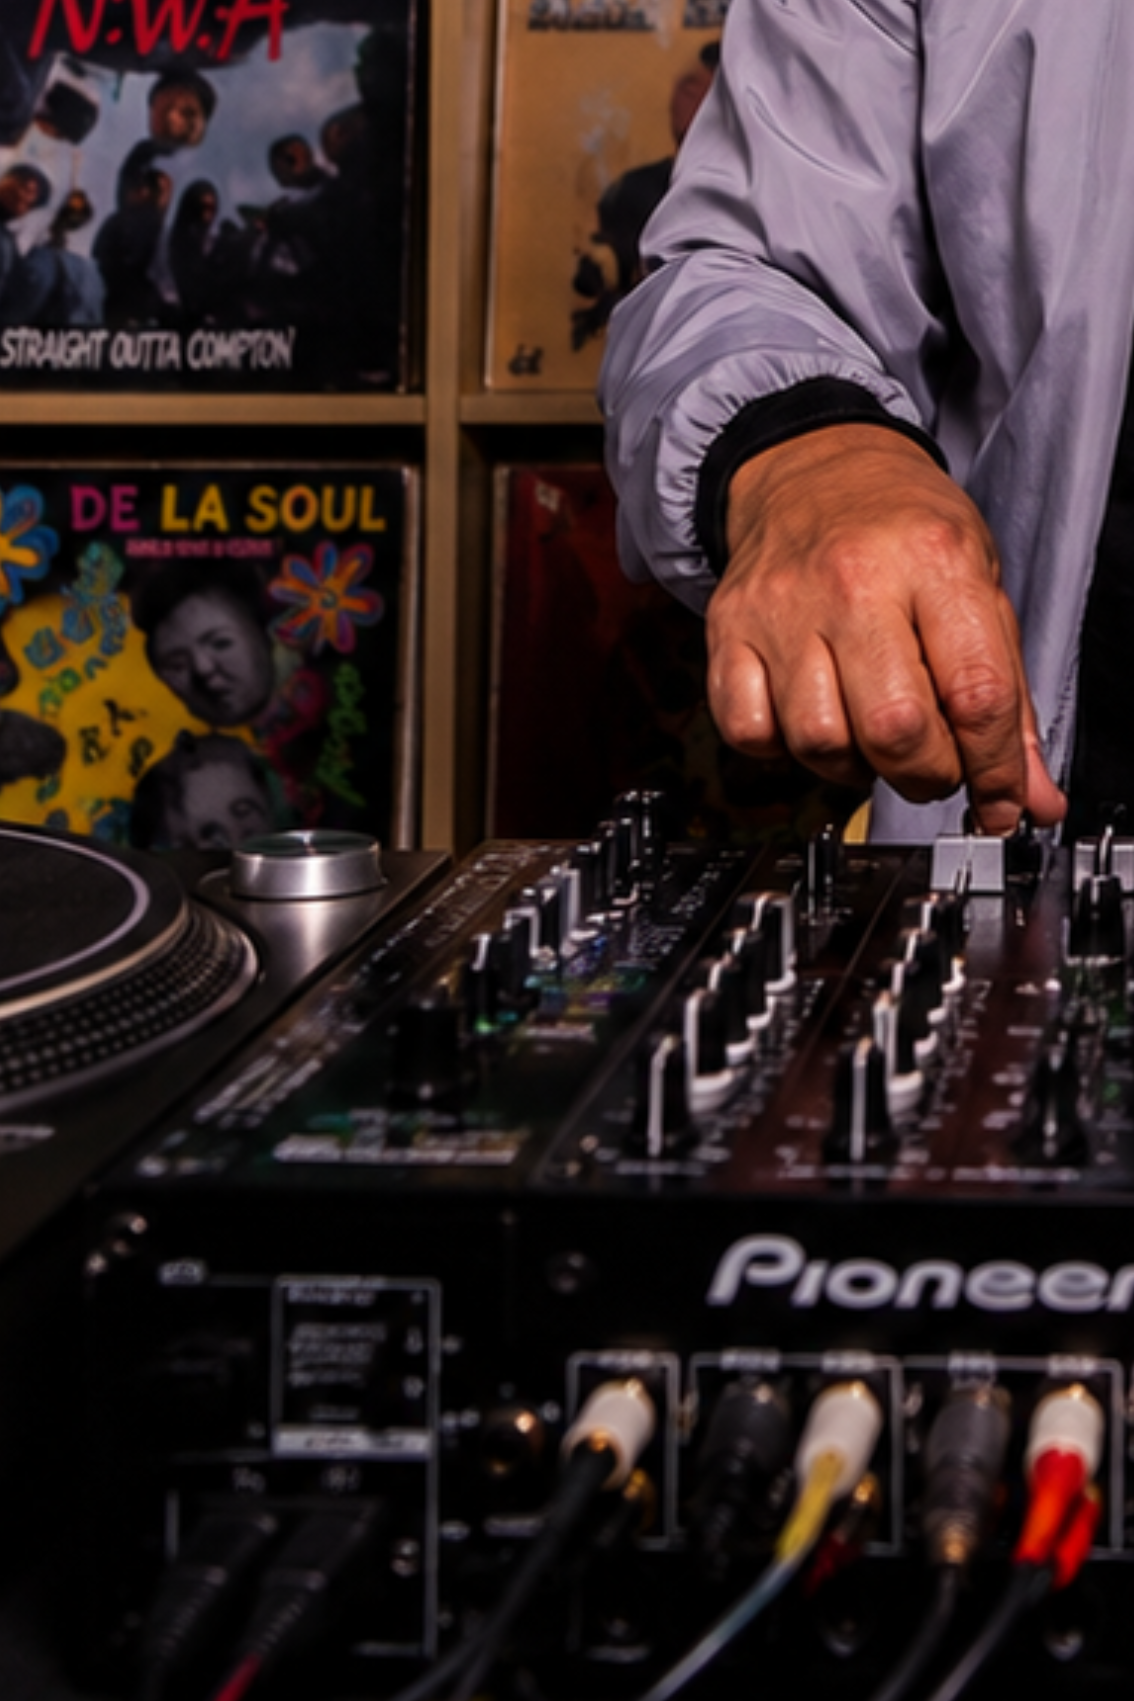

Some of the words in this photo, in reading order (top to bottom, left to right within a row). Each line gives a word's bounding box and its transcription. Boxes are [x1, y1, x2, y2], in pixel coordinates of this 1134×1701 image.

[0, 329, 109, 370] STRAIGHT
[110, 330, 180, 370] OUTTA
[187, 328, 295, 370] COMPTON
[70, 485, 140, 532] DE
[160, 485, 229, 532] LA
[245, 485, 386, 532] SOUL
